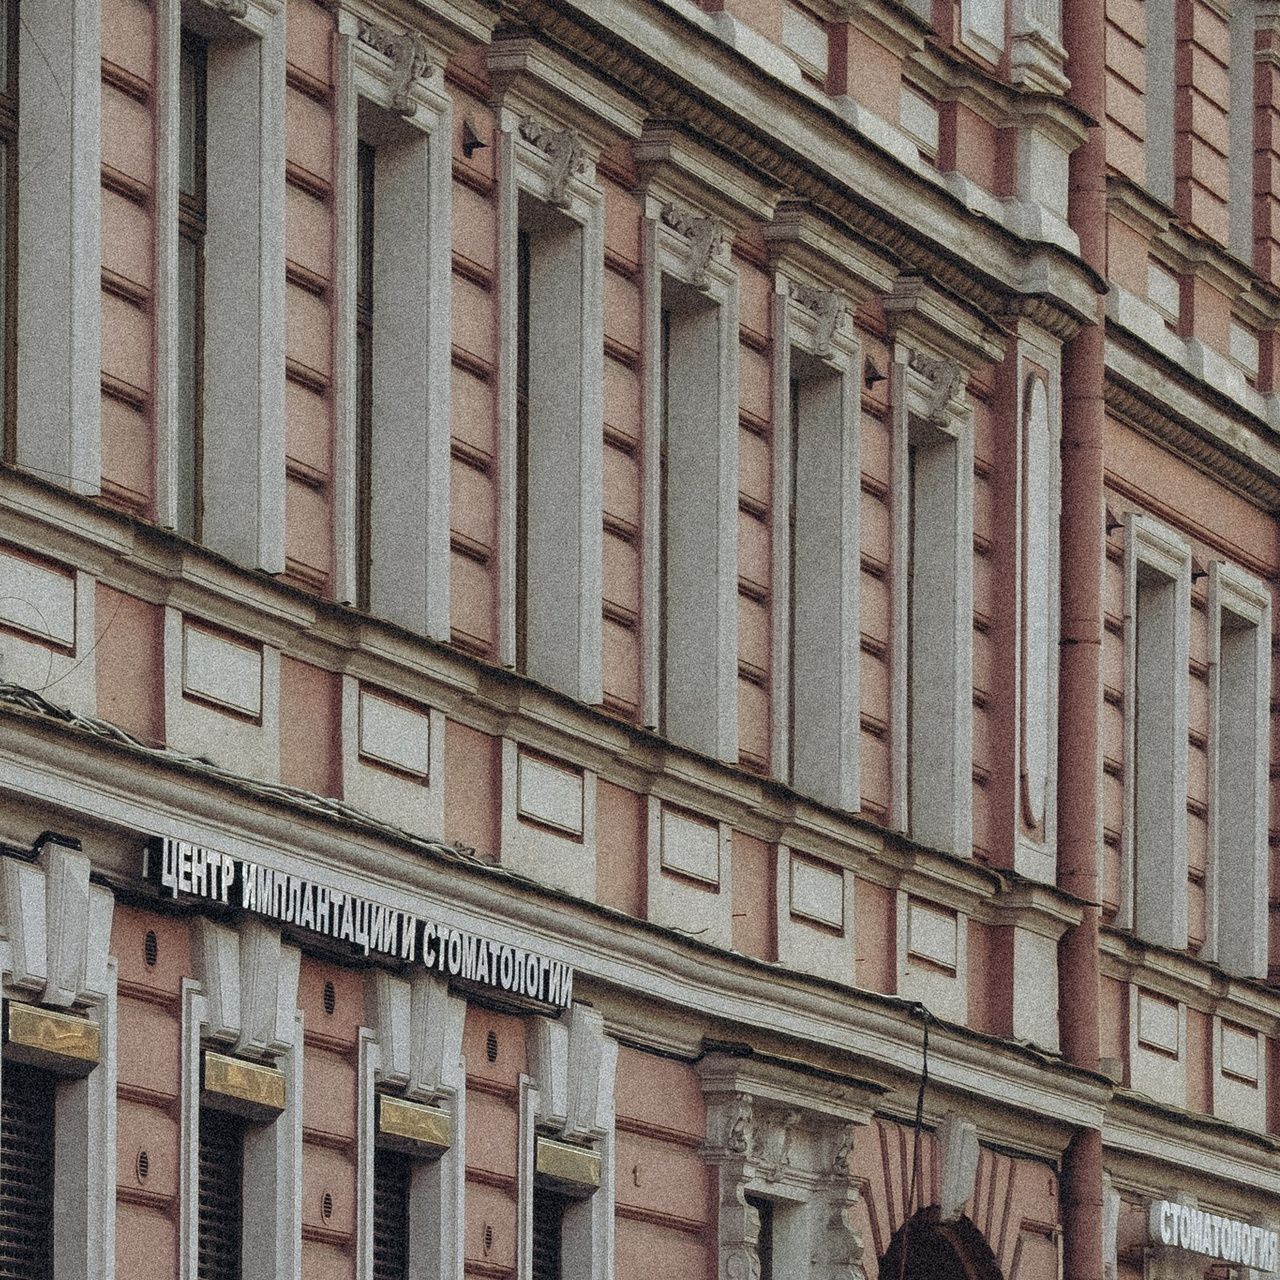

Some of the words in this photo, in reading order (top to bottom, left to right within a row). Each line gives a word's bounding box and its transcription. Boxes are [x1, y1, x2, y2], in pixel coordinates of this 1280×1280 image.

[161, 838, 235, 903] ЦЕНТР
[242, 862, 398, 955] ИМПЛАНТАЦИИ
[401, 915, 416, 960] И
[422, 920, 573, 1008] СТОМАТОЛОГИИ
[1161, 1200, 1278, 1273] СТОМАТОЛОГИЯ
